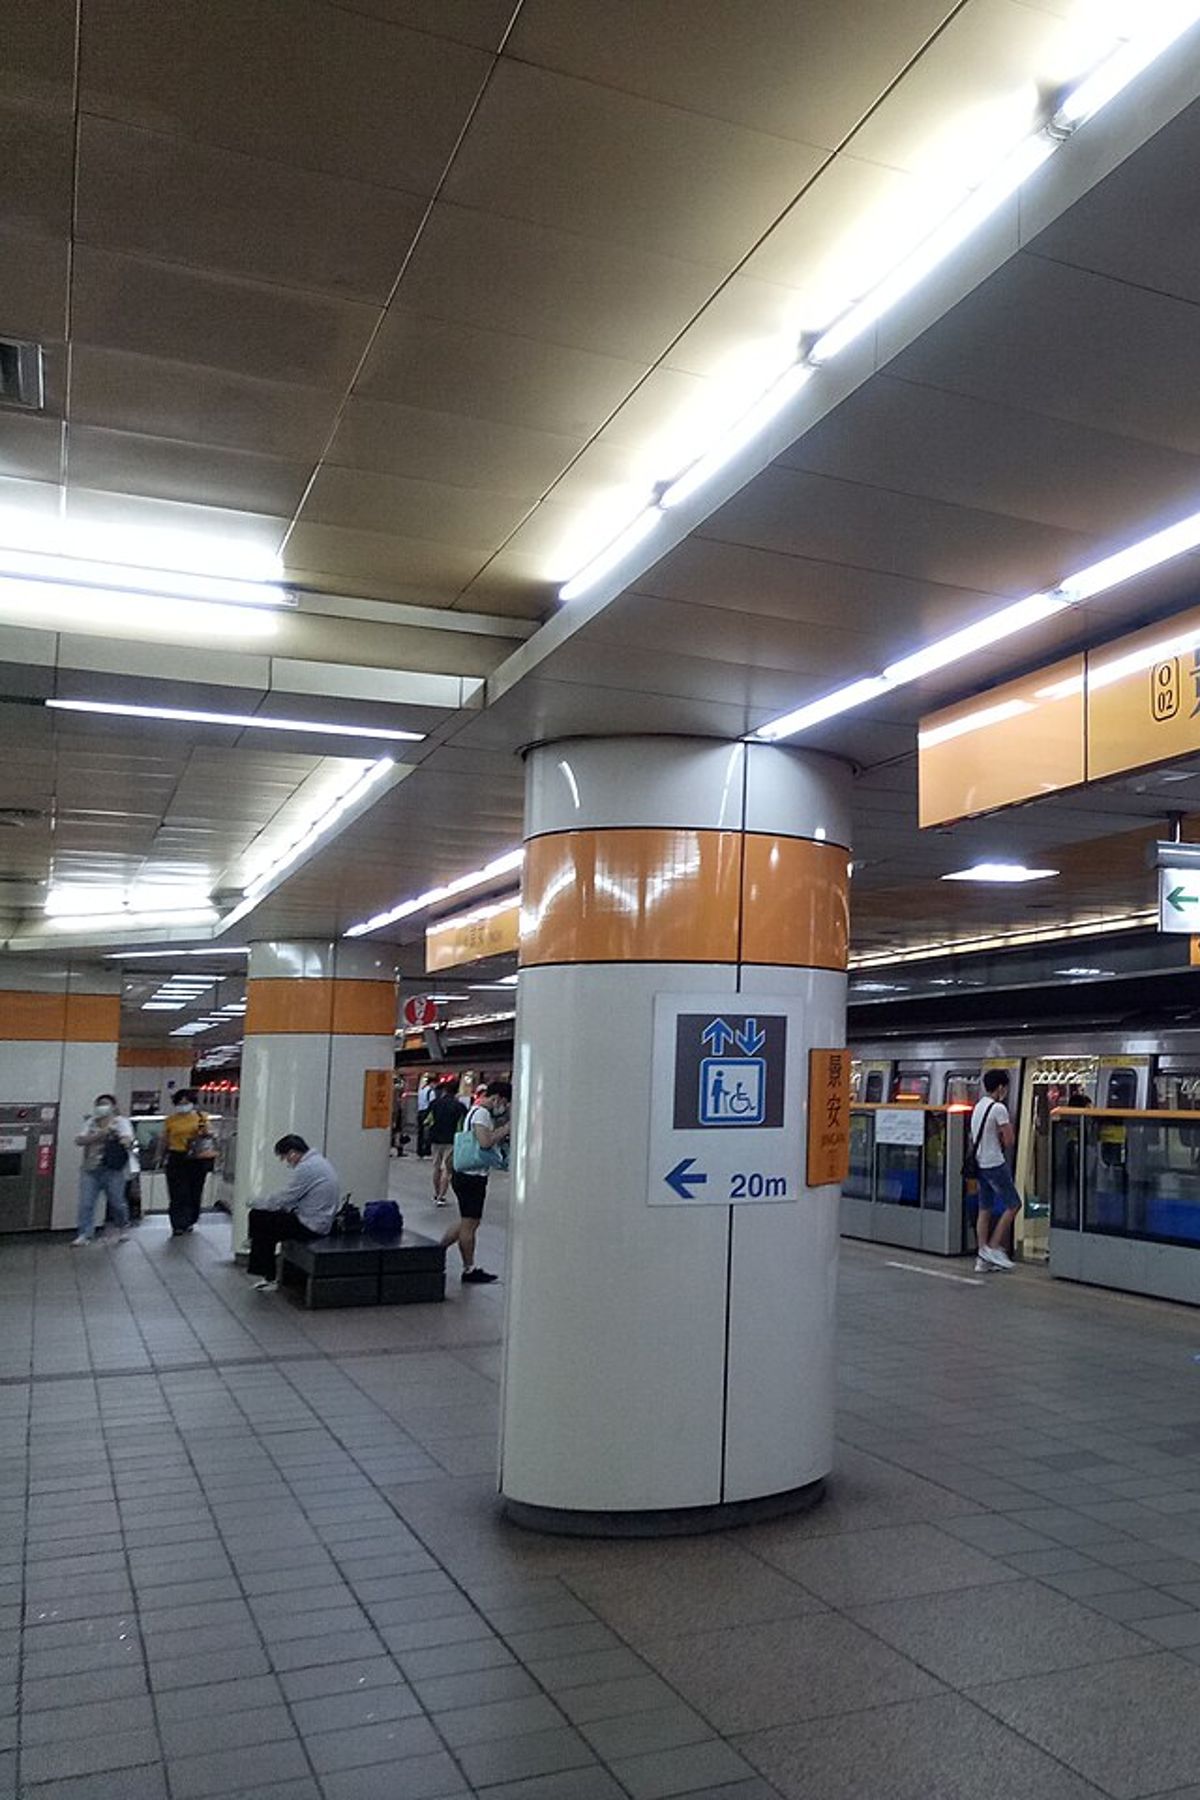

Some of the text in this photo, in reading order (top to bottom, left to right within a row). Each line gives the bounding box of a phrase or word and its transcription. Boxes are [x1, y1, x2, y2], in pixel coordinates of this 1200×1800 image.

[1158, 690, 1173, 713] 02
[827, 1055, 842, 1127] 景安
[730, 1173, 786, 1198] 20m
